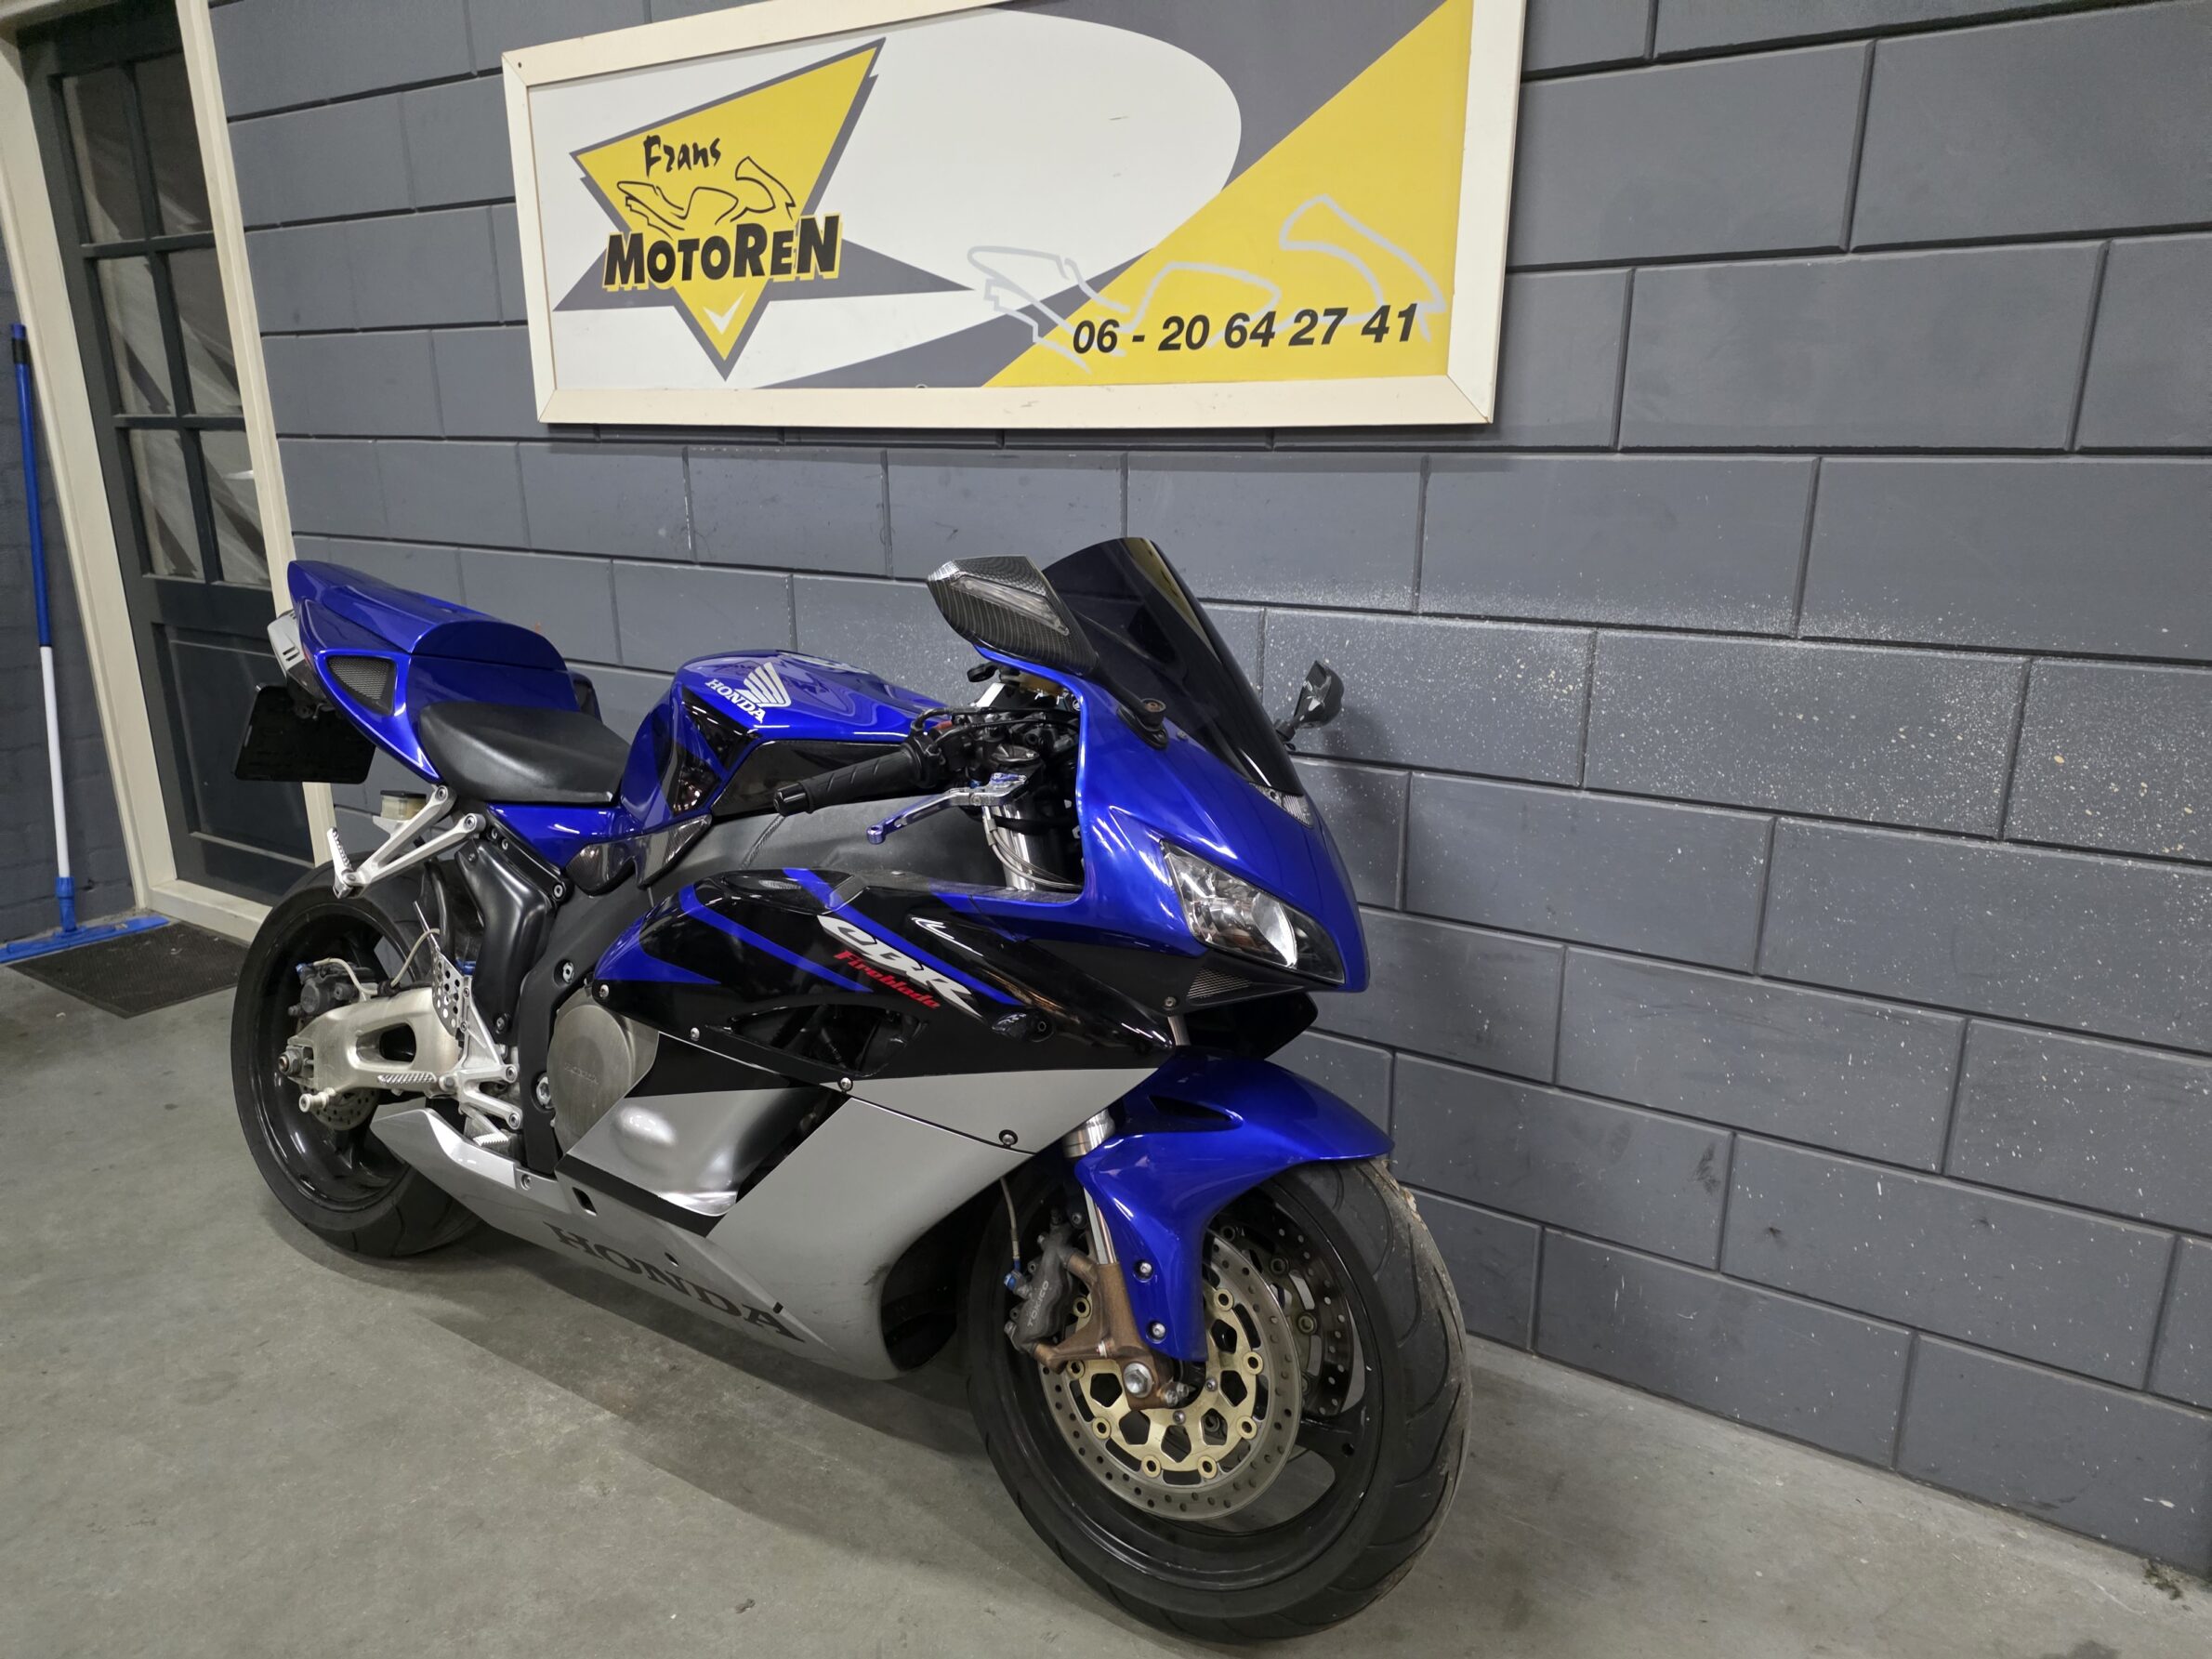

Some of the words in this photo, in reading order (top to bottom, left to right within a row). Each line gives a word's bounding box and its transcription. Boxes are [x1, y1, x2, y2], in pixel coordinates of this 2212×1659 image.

[643, 135, 721, 178] Frans
[603, 215, 840, 286] MOTOREN
[1073, 319, 1118, 353] 06
[1132, 334, 1146, 343] -
[1158, 314, 1209, 351] 20
[1224, 310, 1276, 348] 64
[1288, 307, 1349, 346] 27
[1361, 303, 1417, 343] 41
[704, 678, 766, 724] HONDA
[817, 915, 983, 1019] CBR
[834, 950, 941, 1008] Fireblade
[543, 1221, 806, 1343] HONDA
[1027, 1280, 1049, 1327] TOKICO
